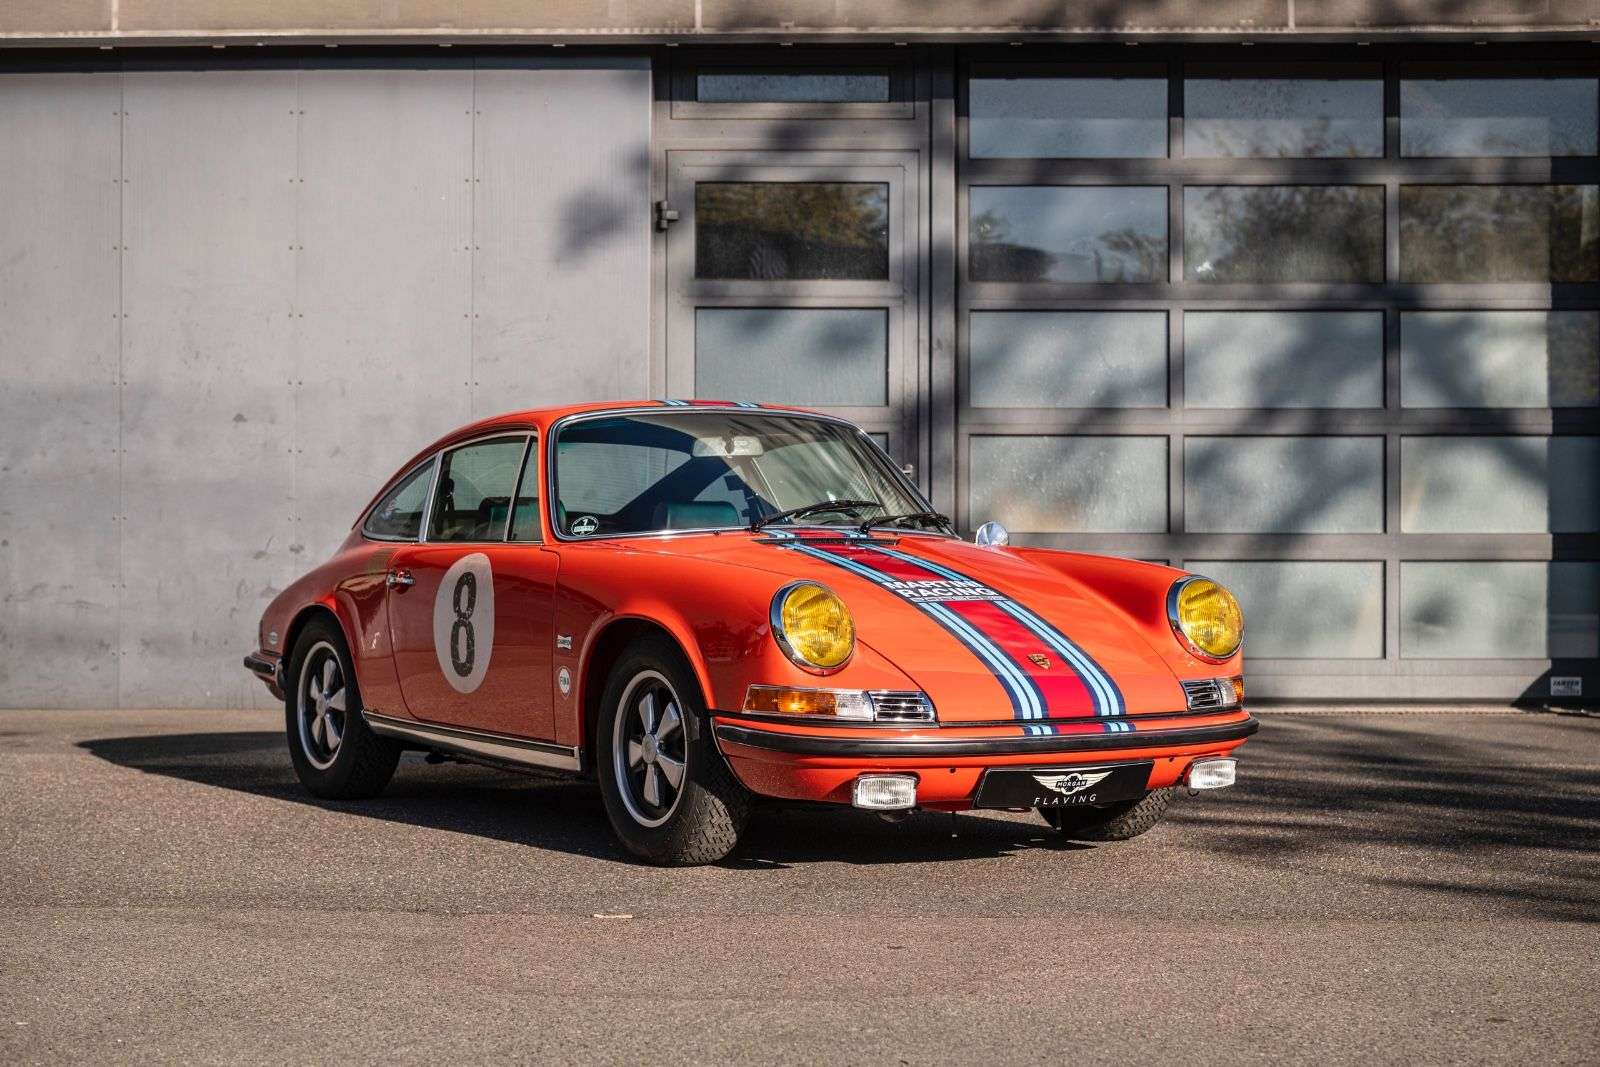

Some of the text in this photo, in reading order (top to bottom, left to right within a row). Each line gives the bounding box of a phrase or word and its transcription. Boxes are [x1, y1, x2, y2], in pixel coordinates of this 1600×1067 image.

[882, 580, 984, 589] MARTINI
[895, 587, 999, 597] RACING
[451, 572, 477, 677] 8
[1033, 793, 1097, 805] FLAVING
